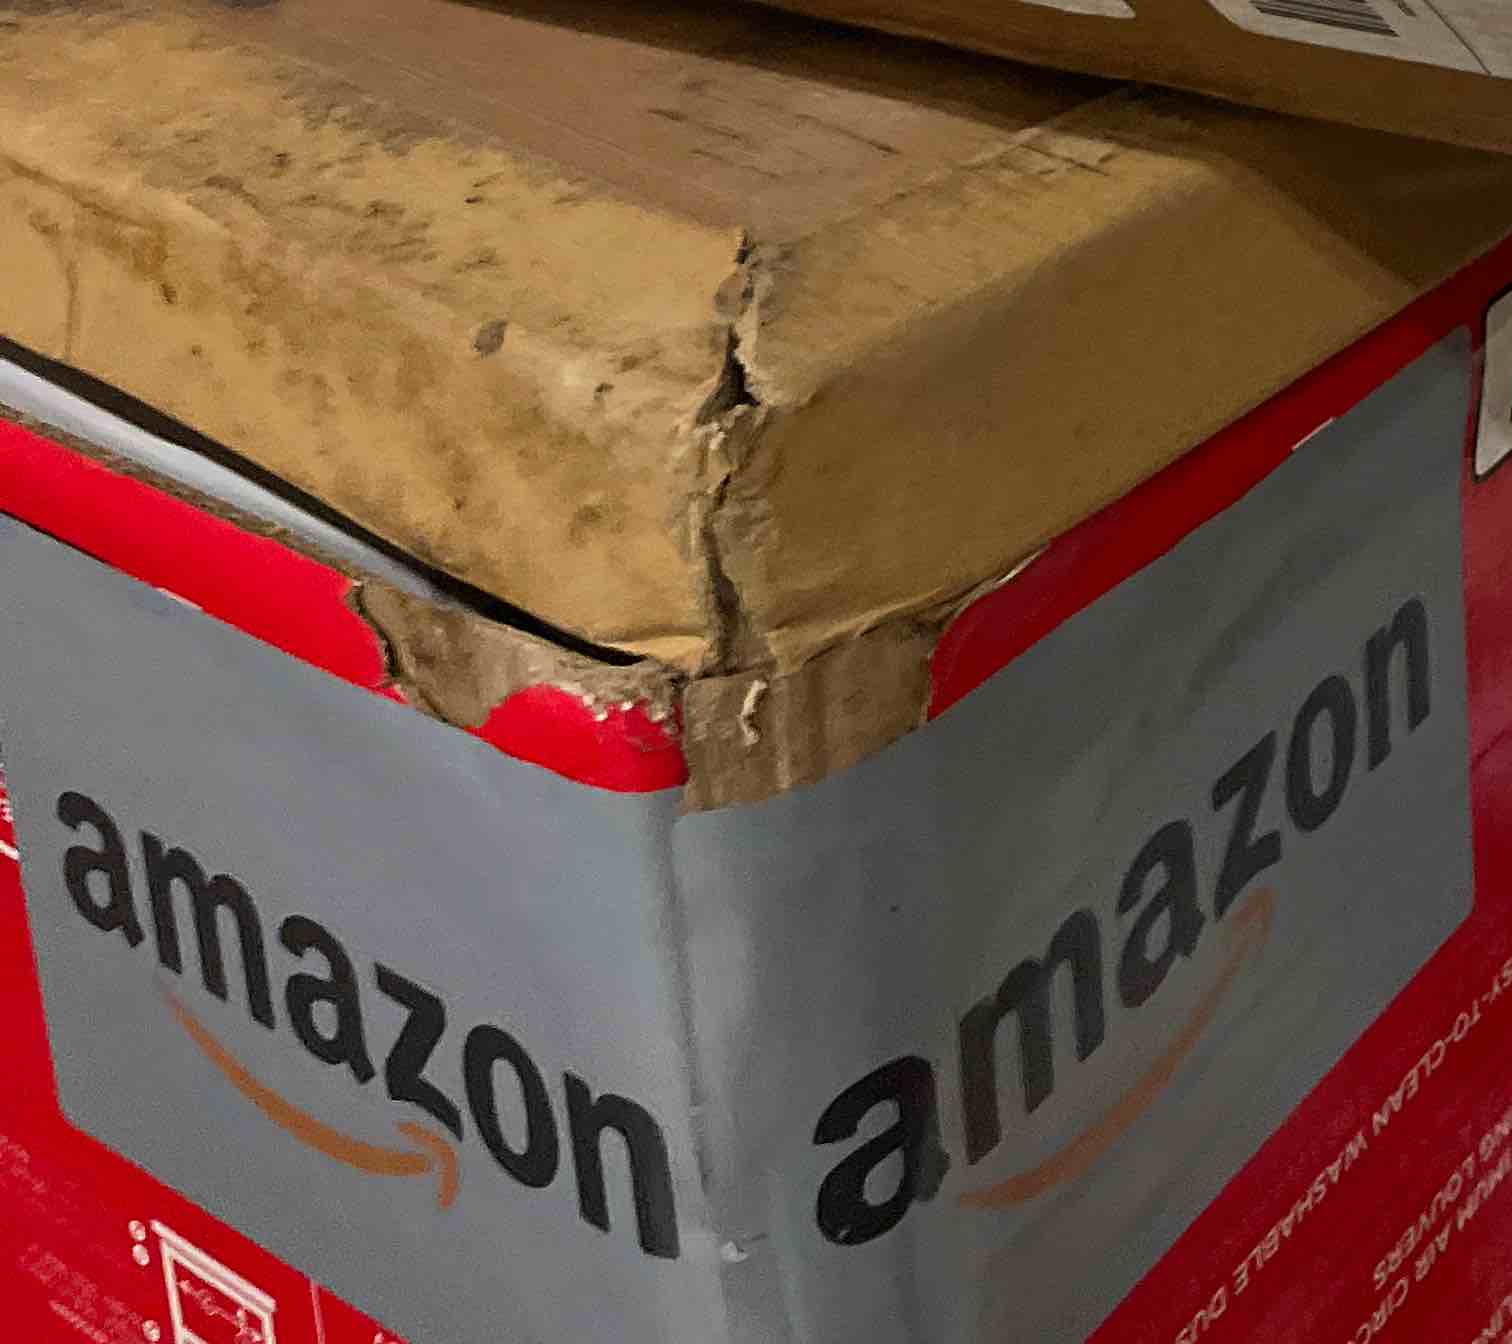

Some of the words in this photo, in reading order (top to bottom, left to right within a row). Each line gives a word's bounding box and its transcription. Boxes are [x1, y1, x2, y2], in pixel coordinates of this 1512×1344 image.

[57, 790, 680, 1260] amazon
[812, 592, 1434, 1248] amazon
[1231, 1129, 1368, 1297] WASHABLE
[1372, 1151, 1476, 1291] LOUVERS
